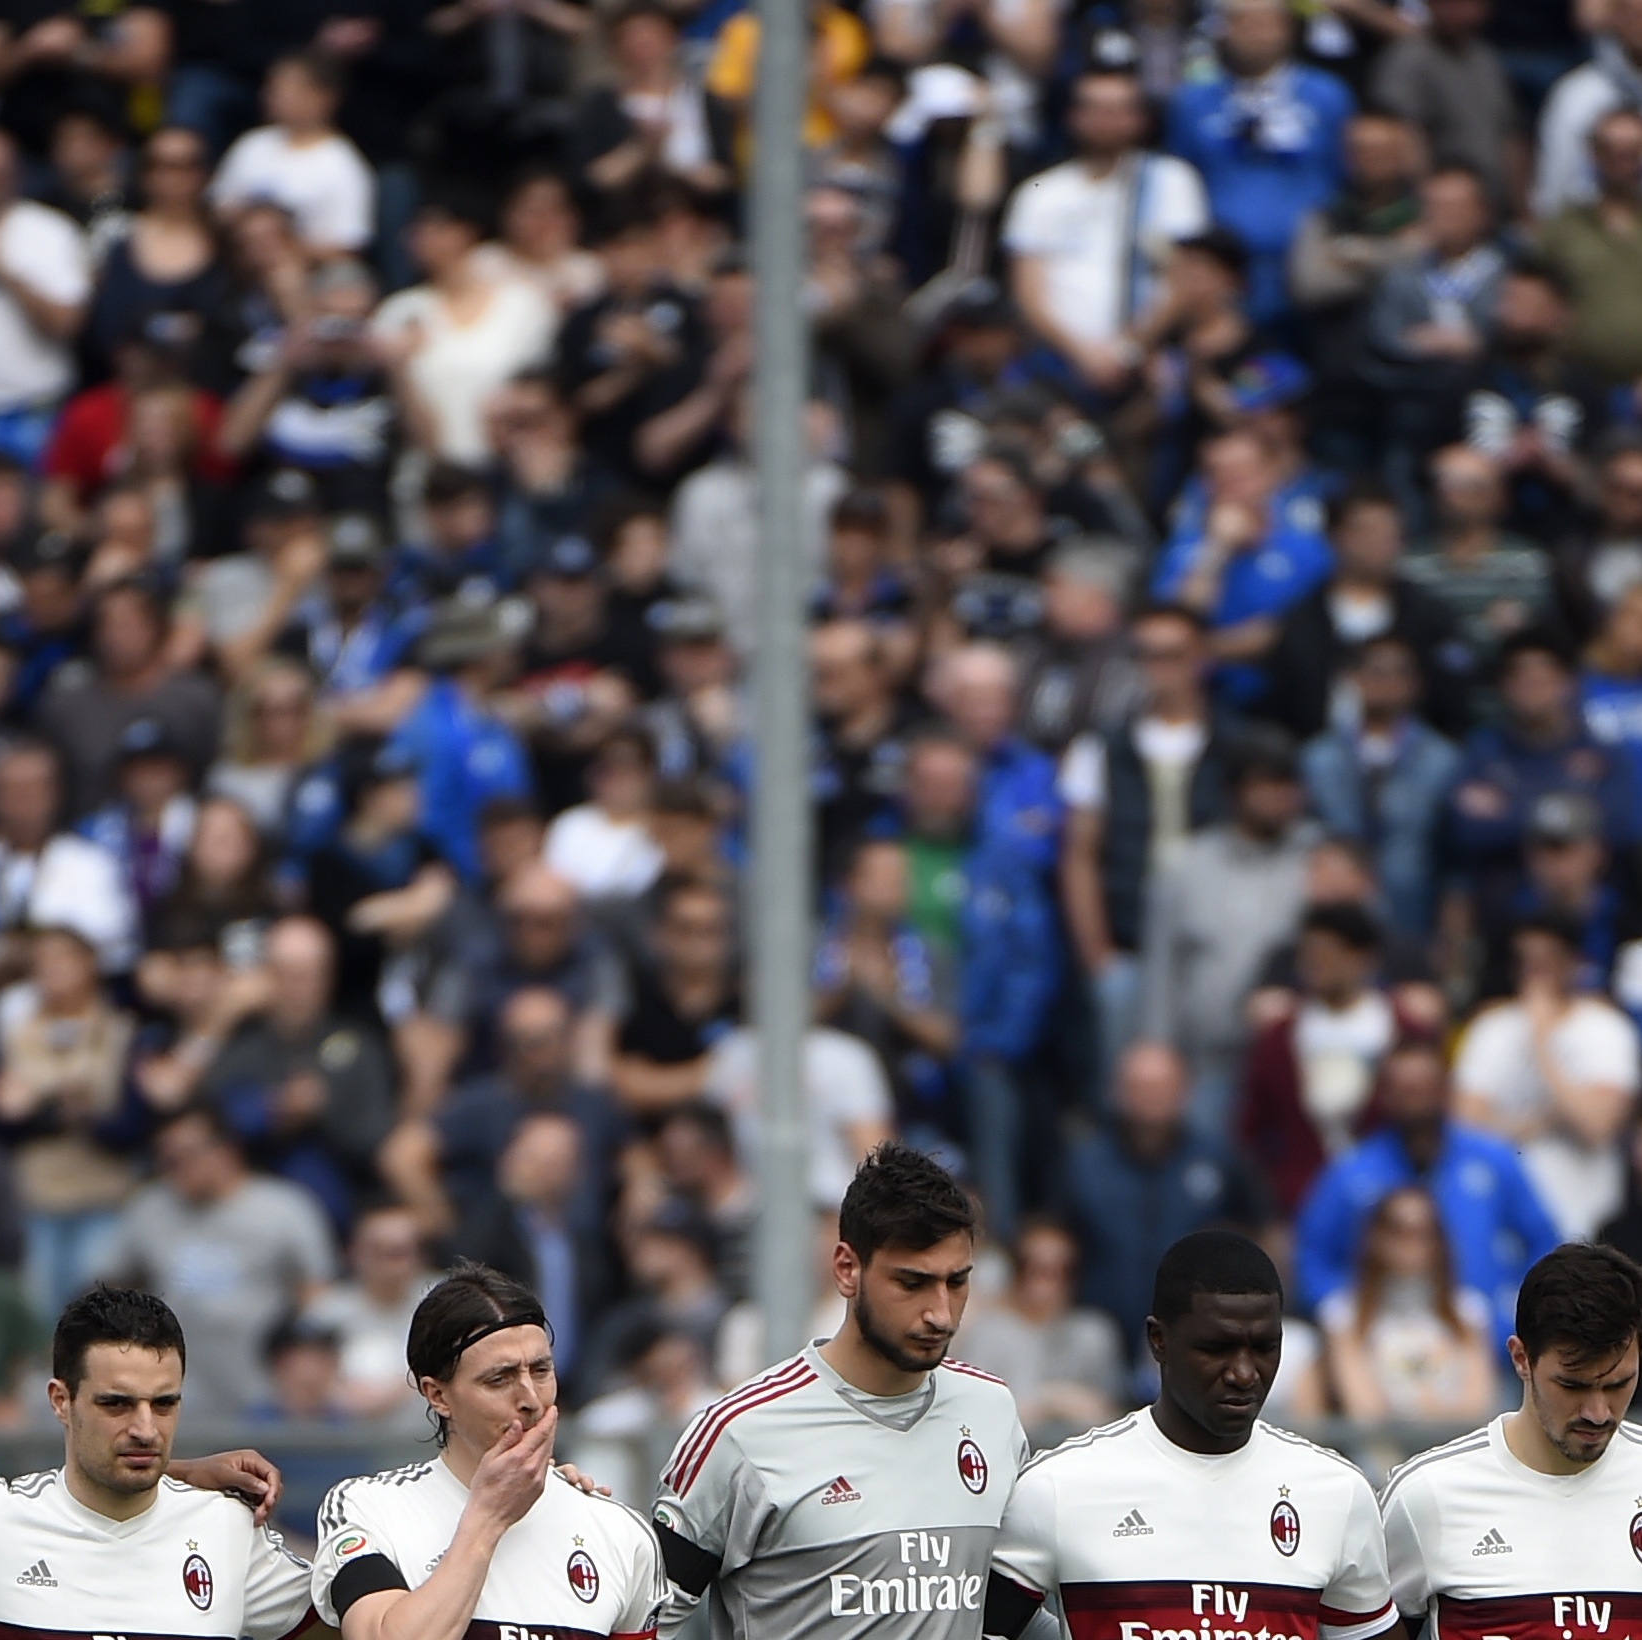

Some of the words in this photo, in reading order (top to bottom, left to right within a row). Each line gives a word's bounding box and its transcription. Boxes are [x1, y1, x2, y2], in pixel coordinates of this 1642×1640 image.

[821, 1491, 862, 1507] adidas
[1113, 1525, 1154, 1538] adidas
[899, 1532, 951, 1568] Fly
[1472, 1544, 1513, 1557] adidas
[17, 1574, 58, 1588] adidas
[830, 1566, 983, 1617] Emirate
[1191, 1584, 1249, 1623] Fly
[1552, 1596, 1612, 1633] Fly
